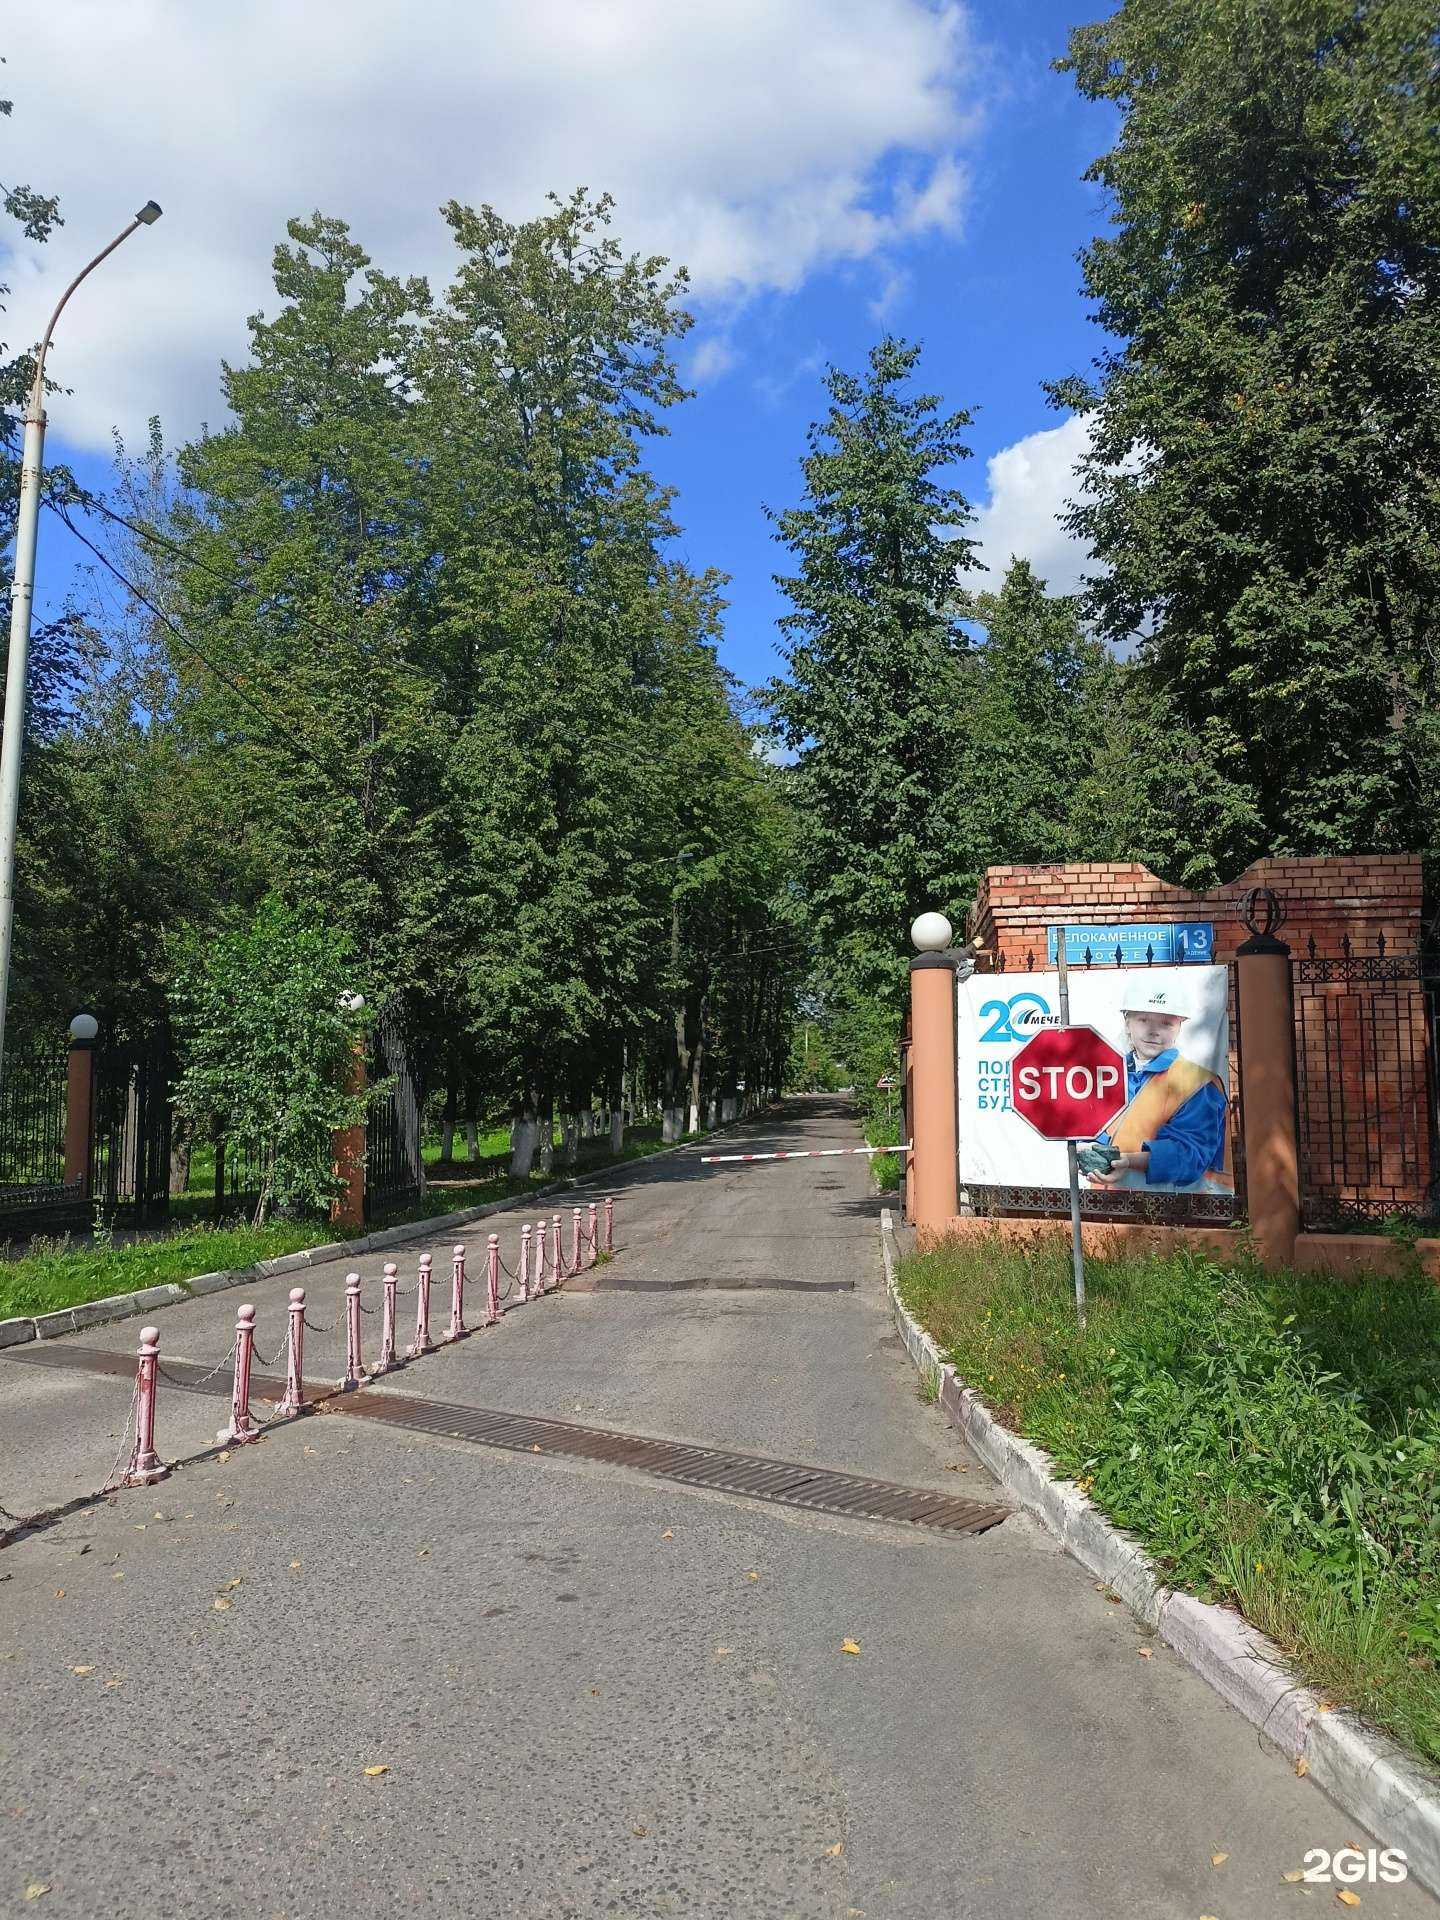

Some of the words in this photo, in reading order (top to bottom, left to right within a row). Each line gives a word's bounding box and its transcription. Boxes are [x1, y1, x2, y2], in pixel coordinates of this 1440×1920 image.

[1178, 930, 1207, 948] 13
[979, 992, 1050, 1042] 20
[1031, 1016, 1062, 1025] МЕЧЕ
[1018, 1066, 1119, 1100] STOP
